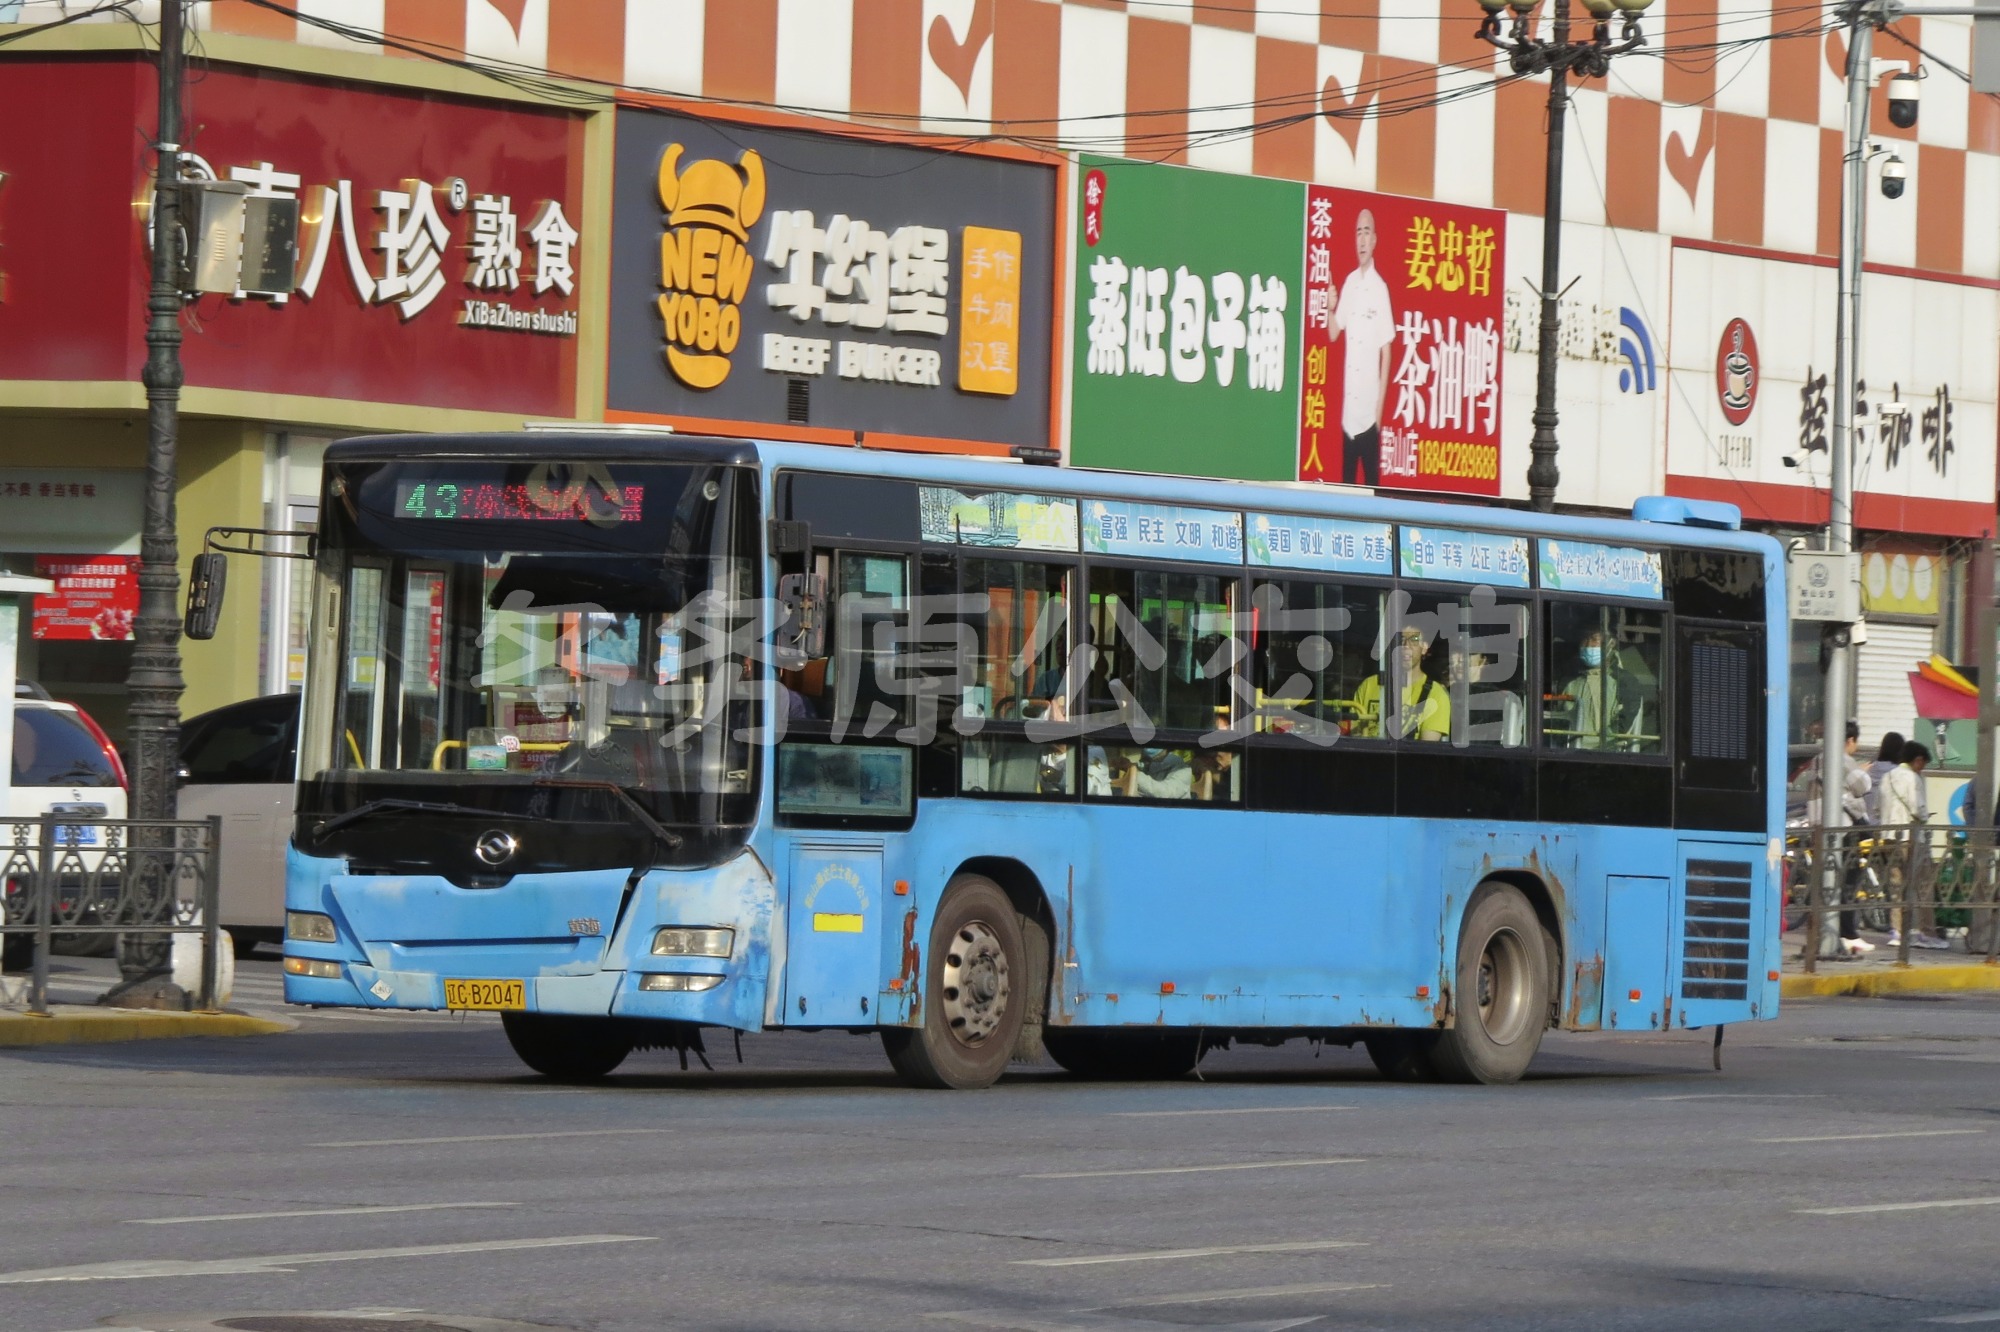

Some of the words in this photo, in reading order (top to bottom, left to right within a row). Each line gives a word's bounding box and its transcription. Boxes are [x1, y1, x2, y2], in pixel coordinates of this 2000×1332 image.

[474, 194, 578, 297] 熟食
[662, 227, 754, 304] NEW
[967, 248, 1015, 282] 手作
[1308, 197, 1332, 329] 茶油鸭
[1405, 216, 1496, 297] 姜忠哲
[764, 210, 949, 335] 牛约堡
[465, 300, 530, 329] XiBaZhen
[532, 308, 577, 334] shushi
[659, 292, 741, 354] YOBO
[968, 293, 1014, 329] 牛肉
[1087, 255, 1288, 392] 蒸旺包子铺
[763, 333, 831, 374] BEEF
[838, 341, 941, 386] BURGER
[965, 340, 1012, 374] 汉堡
[1393, 310, 1499, 436] 茶油鸭
[1303, 344, 1327, 473] 创始人
[1380, 427, 1418, 477] 鞍山店
[0, 483, 31, 497] 不贵
[405, 484, 458, 518] 43
[1100, 514, 1128, 541] 富强
[1138, 517, 1165, 544] 民主
[1175, 521, 1202, 547] 文明
[1212, 524, 1237, 550] 和谐
[1268, 528, 1291, 553] 爱国
[1299, 530, 1323, 555] 敬业
[1332, 533, 1354, 558] 诚信
[1363, 535, 1386, 561] 友善
[1414, 541, 1435, 565] 自由
[1442, 543, 1462, 568] 平等
[1470, 546, 1491, 570] 公正
[1498, 549, 1518, 573] 法治
